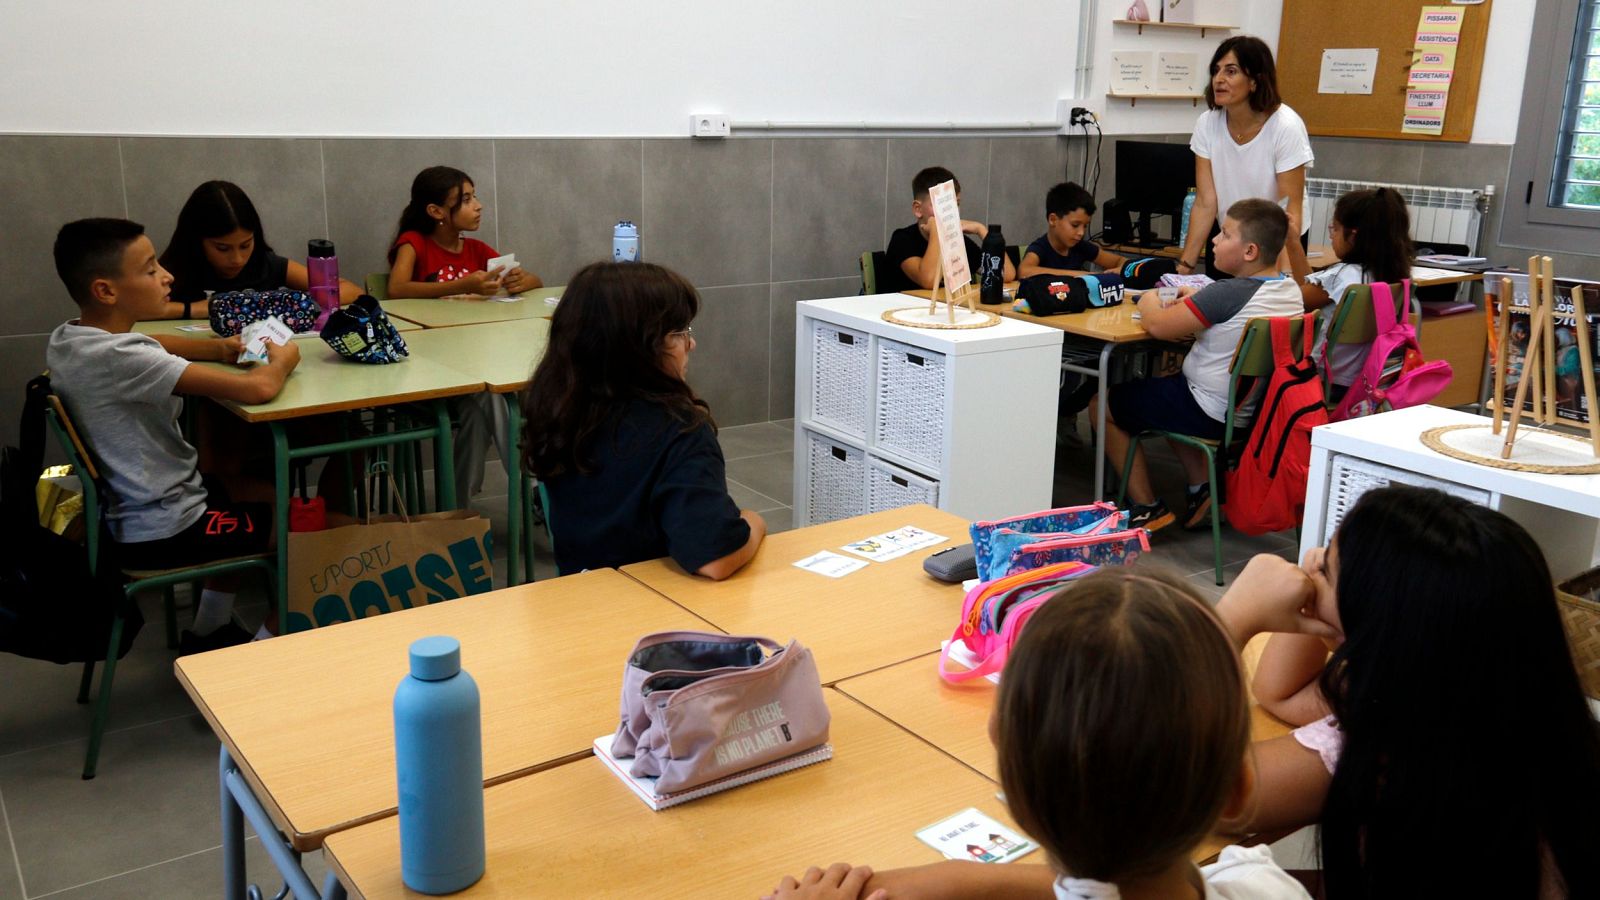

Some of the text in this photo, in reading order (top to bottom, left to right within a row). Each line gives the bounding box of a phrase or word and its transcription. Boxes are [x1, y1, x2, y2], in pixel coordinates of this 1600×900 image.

[1404, 119, 1441, 127] ORDINADORS
[310, 540, 391, 594] ESPORTS
[752, 701, 785, 727] THERE
[715, 745, 728, 767] IS
[726, 740, 744, 762] NO
[741, 726, 782, 755] PLANET
